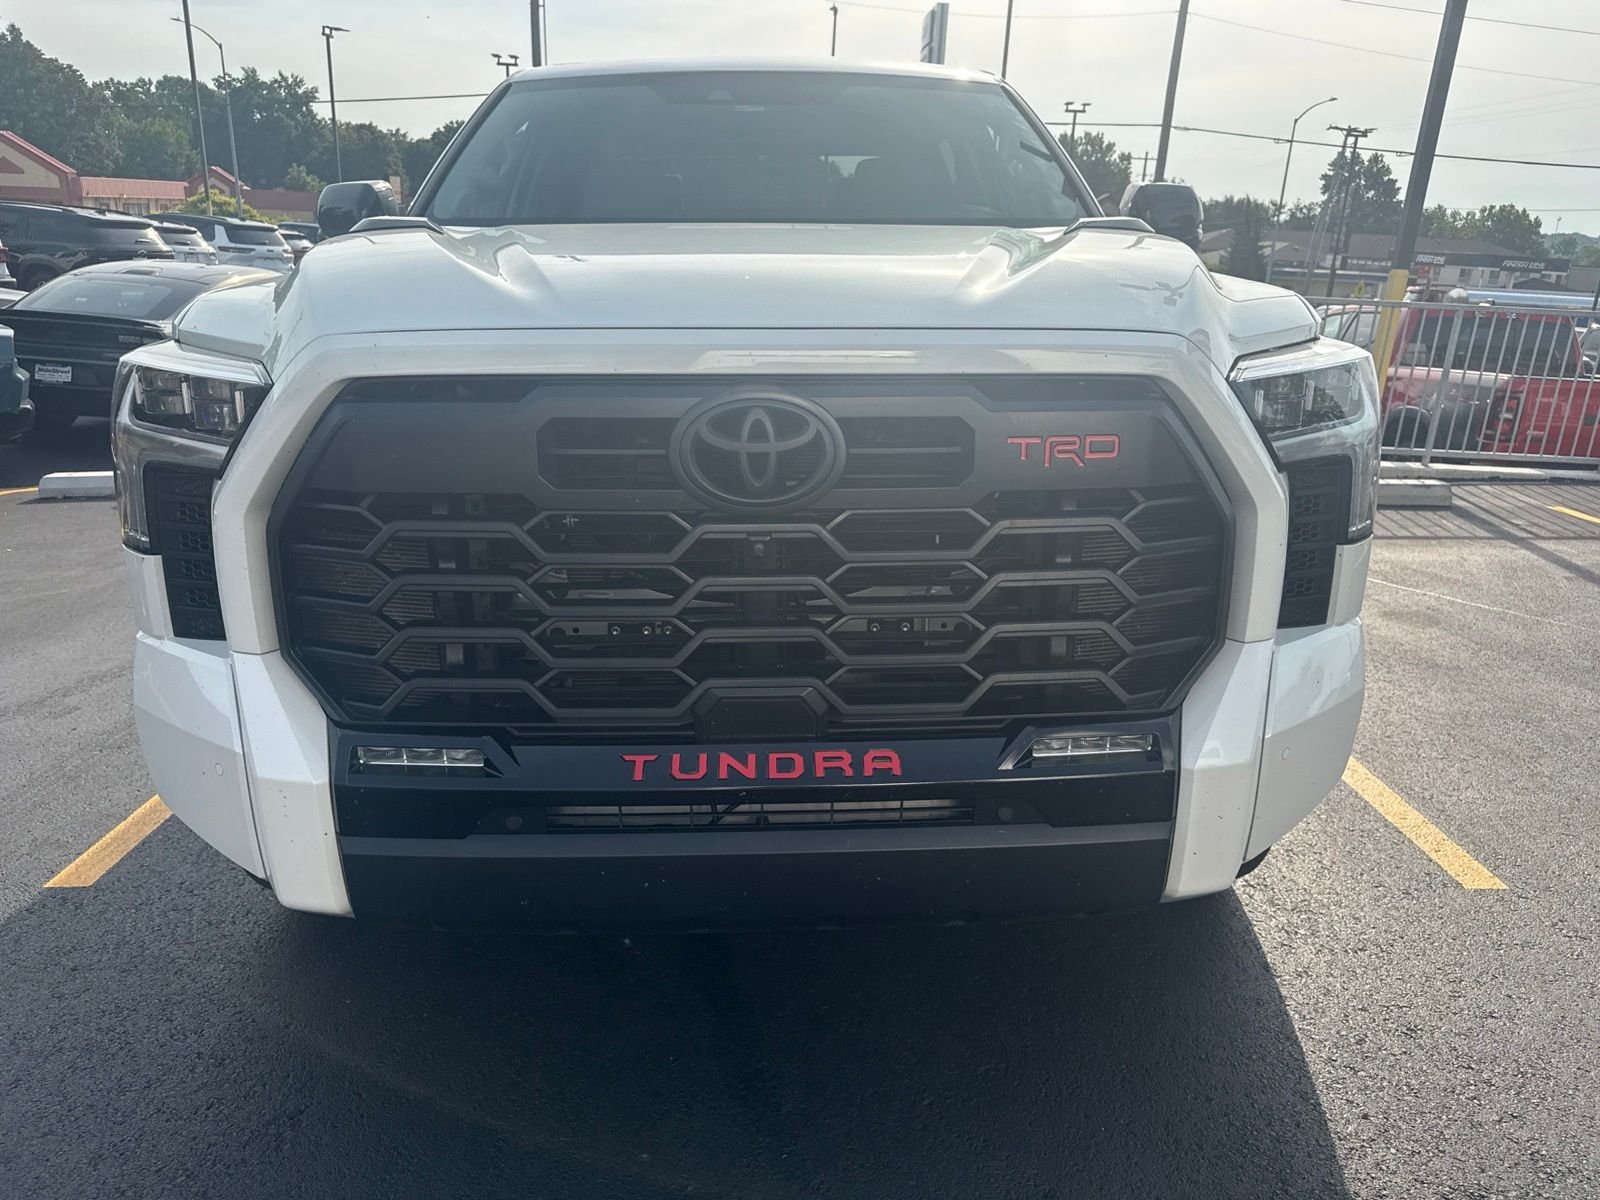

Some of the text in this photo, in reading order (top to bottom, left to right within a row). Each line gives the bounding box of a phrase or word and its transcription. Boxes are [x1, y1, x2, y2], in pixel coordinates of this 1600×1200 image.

[1502, 260, 1529, 268] FINISH
[1007, 434, 1120, 467] TRD
[620, 748, 902, 781] TUNDRA
